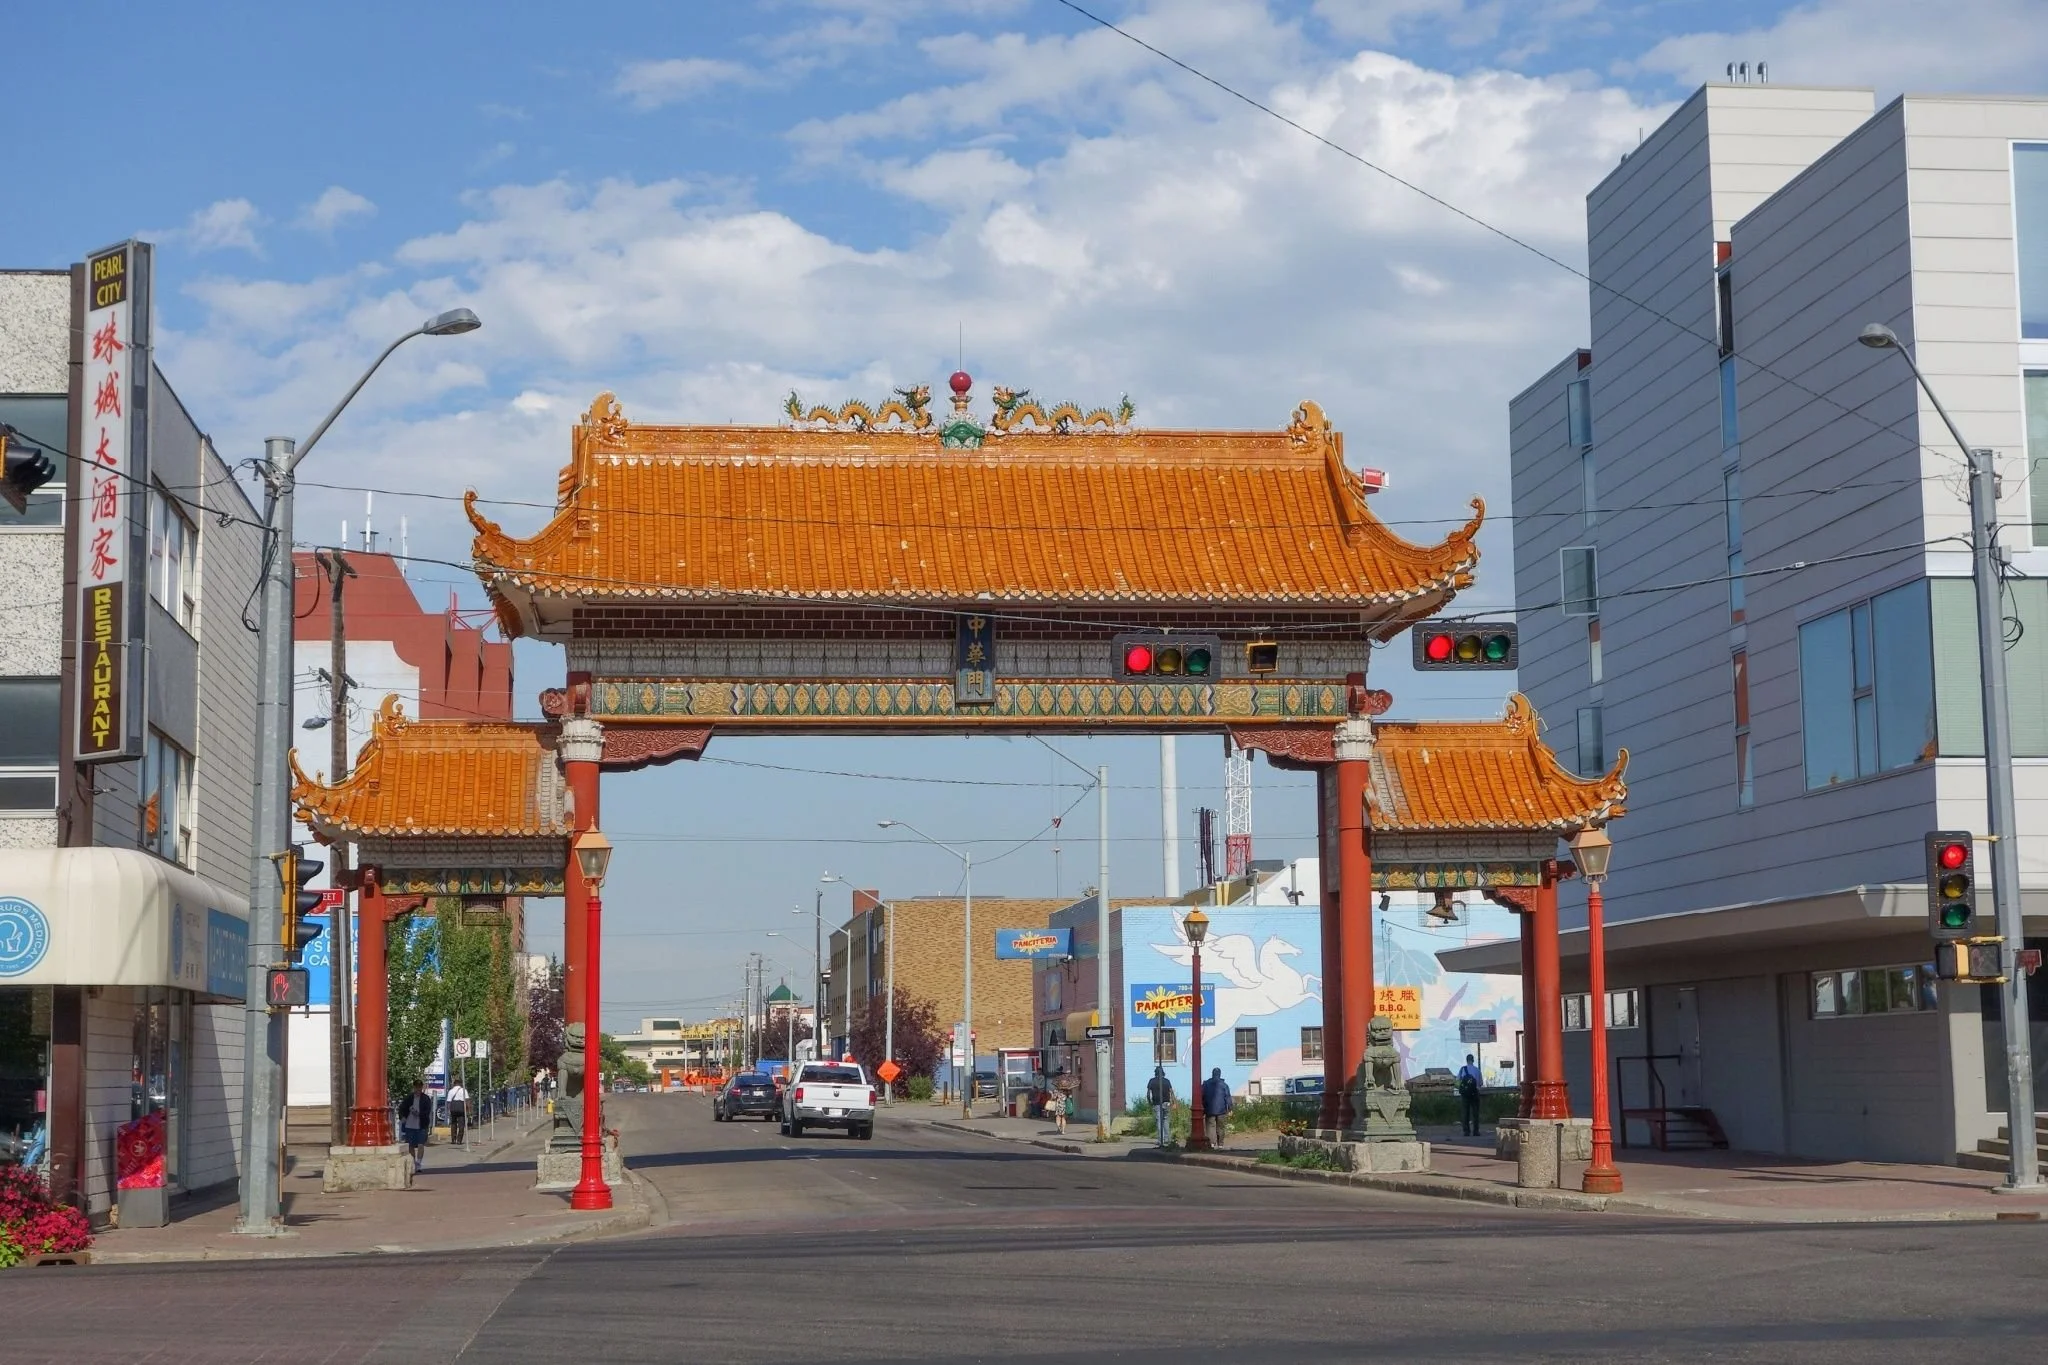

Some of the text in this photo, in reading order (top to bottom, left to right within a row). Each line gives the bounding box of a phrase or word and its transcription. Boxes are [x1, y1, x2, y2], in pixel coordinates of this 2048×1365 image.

[95, 254, 124, 282] PEARL
[97, 280, 121, 306] CITY
[91, 311, 124, 580] 珠城大酒家
[92, 587, 112, 747] RESTAURANT
[966, 615, 986, 697] 中華門
[27, 914, 44, 960] MEDICAL
[1013, 937, 1057, 948] PANCITERIA
[1136, 996, 1203, 1012] PANCITER
[1379, 1004, 1406, 1012] B.B.Q.
